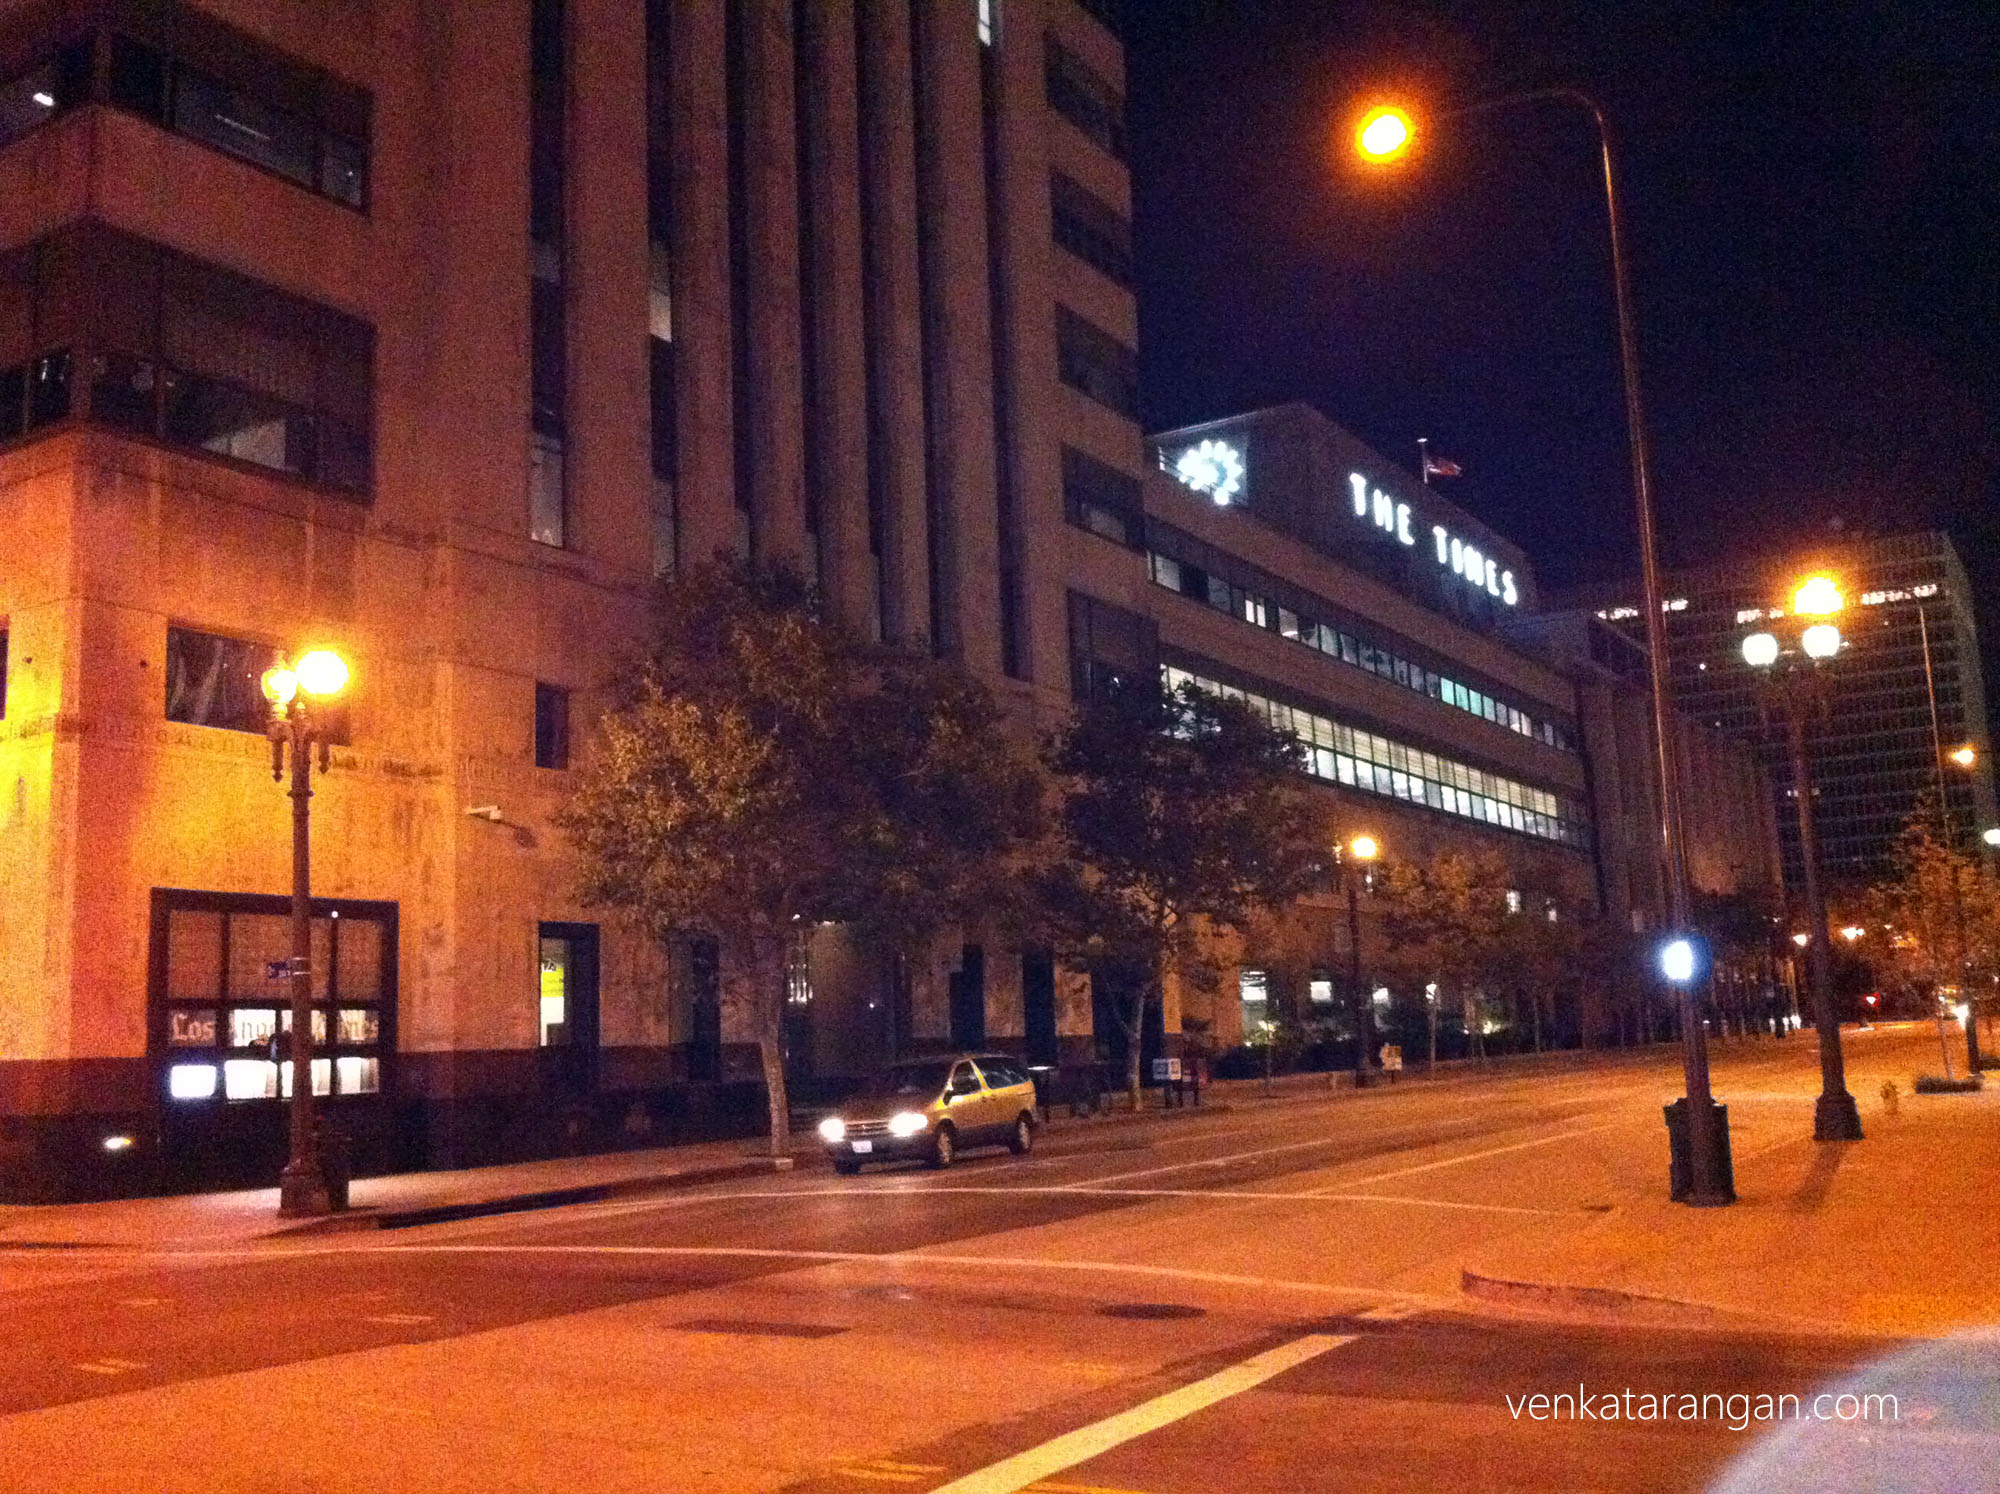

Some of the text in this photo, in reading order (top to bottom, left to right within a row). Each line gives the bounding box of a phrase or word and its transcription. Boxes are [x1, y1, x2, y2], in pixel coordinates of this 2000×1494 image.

[1350, 472, 1518, 605] THE TIMES
[173, 1013, 216, 1042] Los
